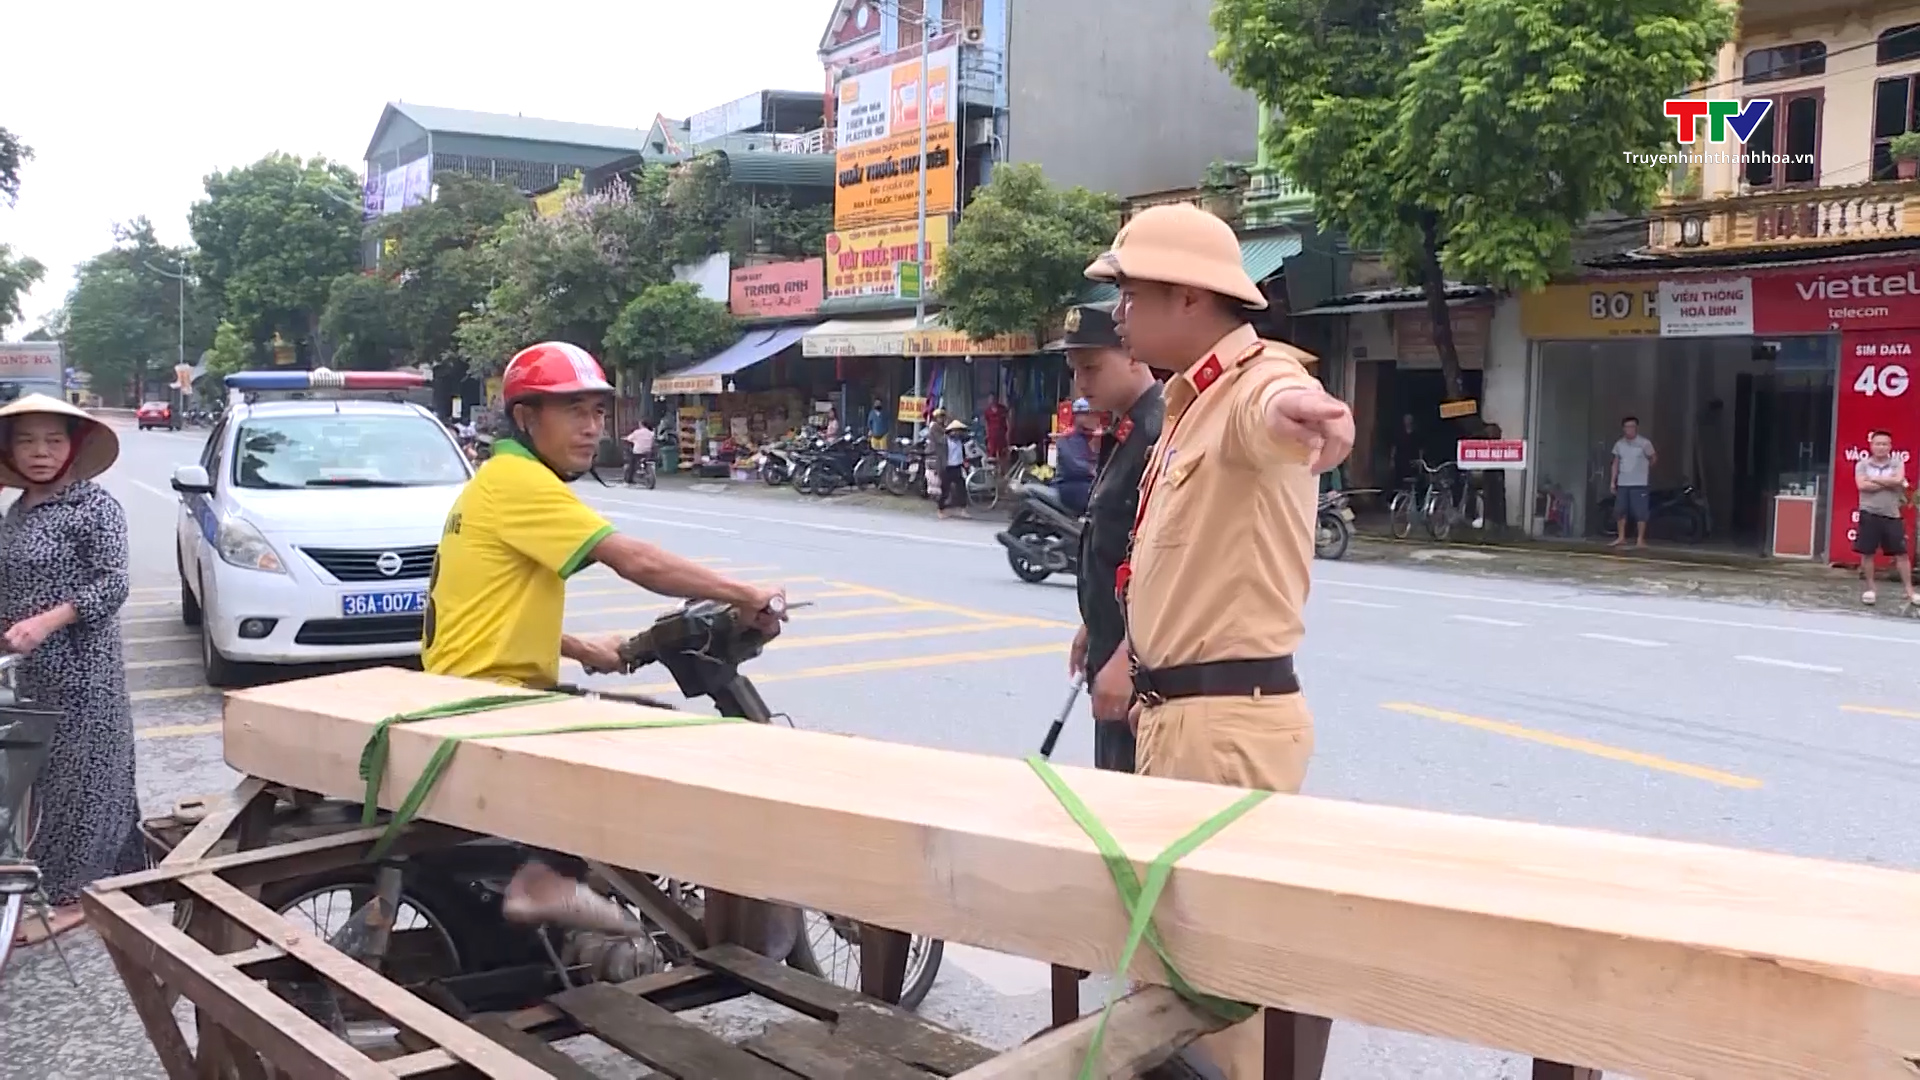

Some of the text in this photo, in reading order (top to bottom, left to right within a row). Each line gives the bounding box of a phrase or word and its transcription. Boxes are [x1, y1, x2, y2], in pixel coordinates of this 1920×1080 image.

[744, 282, 780, 298] TRANG
[784, 279, 809, 294] ANH
[1795, 271, 1920, 301] viettel
[1828, 306, 1889, 318] telecom
[1855, 343, 1912, 357] SIM DATA
[1853, 364, 1910, 397] 4G
